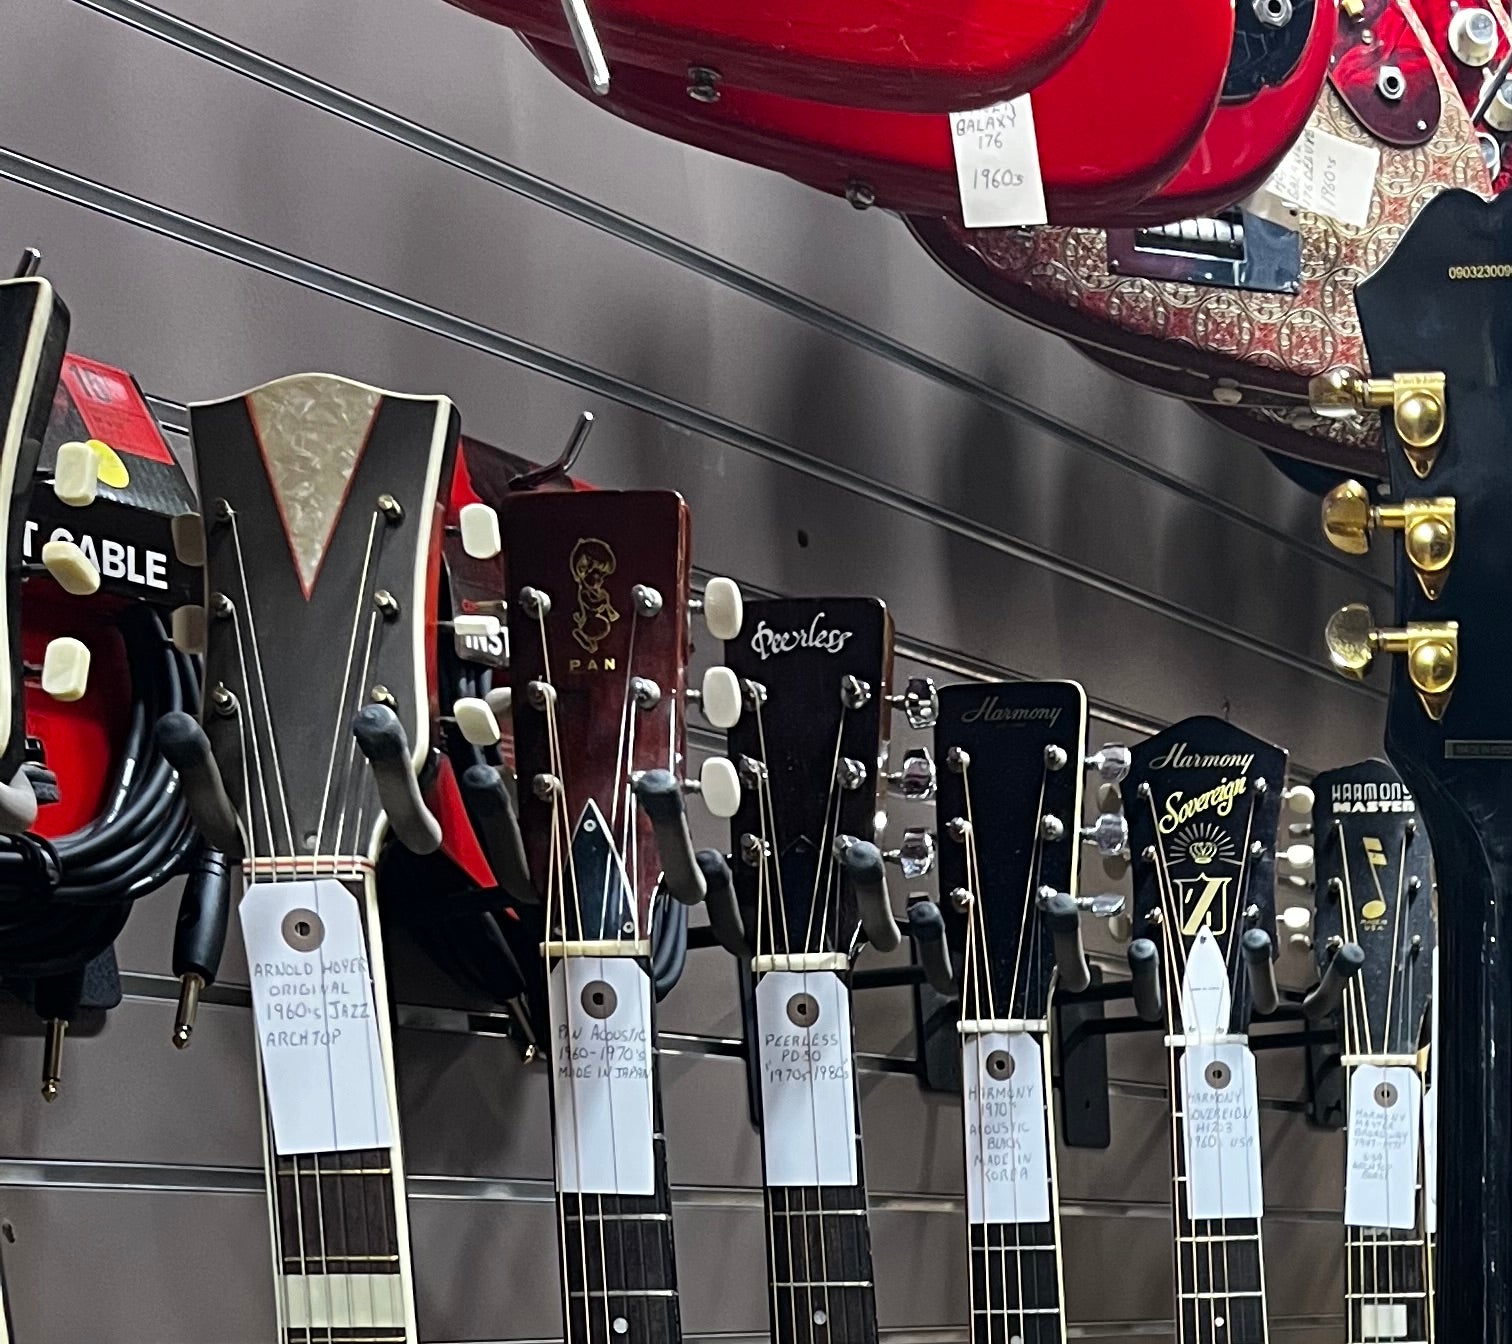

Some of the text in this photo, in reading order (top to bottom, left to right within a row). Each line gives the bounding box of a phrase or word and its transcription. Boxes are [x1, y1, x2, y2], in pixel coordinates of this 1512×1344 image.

[978, 131, 1004, 150] 176
[750, 611, 853, 661] Peerless
[568, 657, 617, 672] PAN
[960, 695, 1064, 729] Harmony
[1148, 741, 1255, 776] Harmony
[1158, 776, 1248, 835] Sovereign
[1332, 800, 1416, 814] MASTER
[253, 962, 314, 978] ARNOLD
[268, 981, 350, 997] ORIGINAL
[328, 1001, 371, 1020] JAZZ
[764, 1032, 840, 1048] PEERLESS
